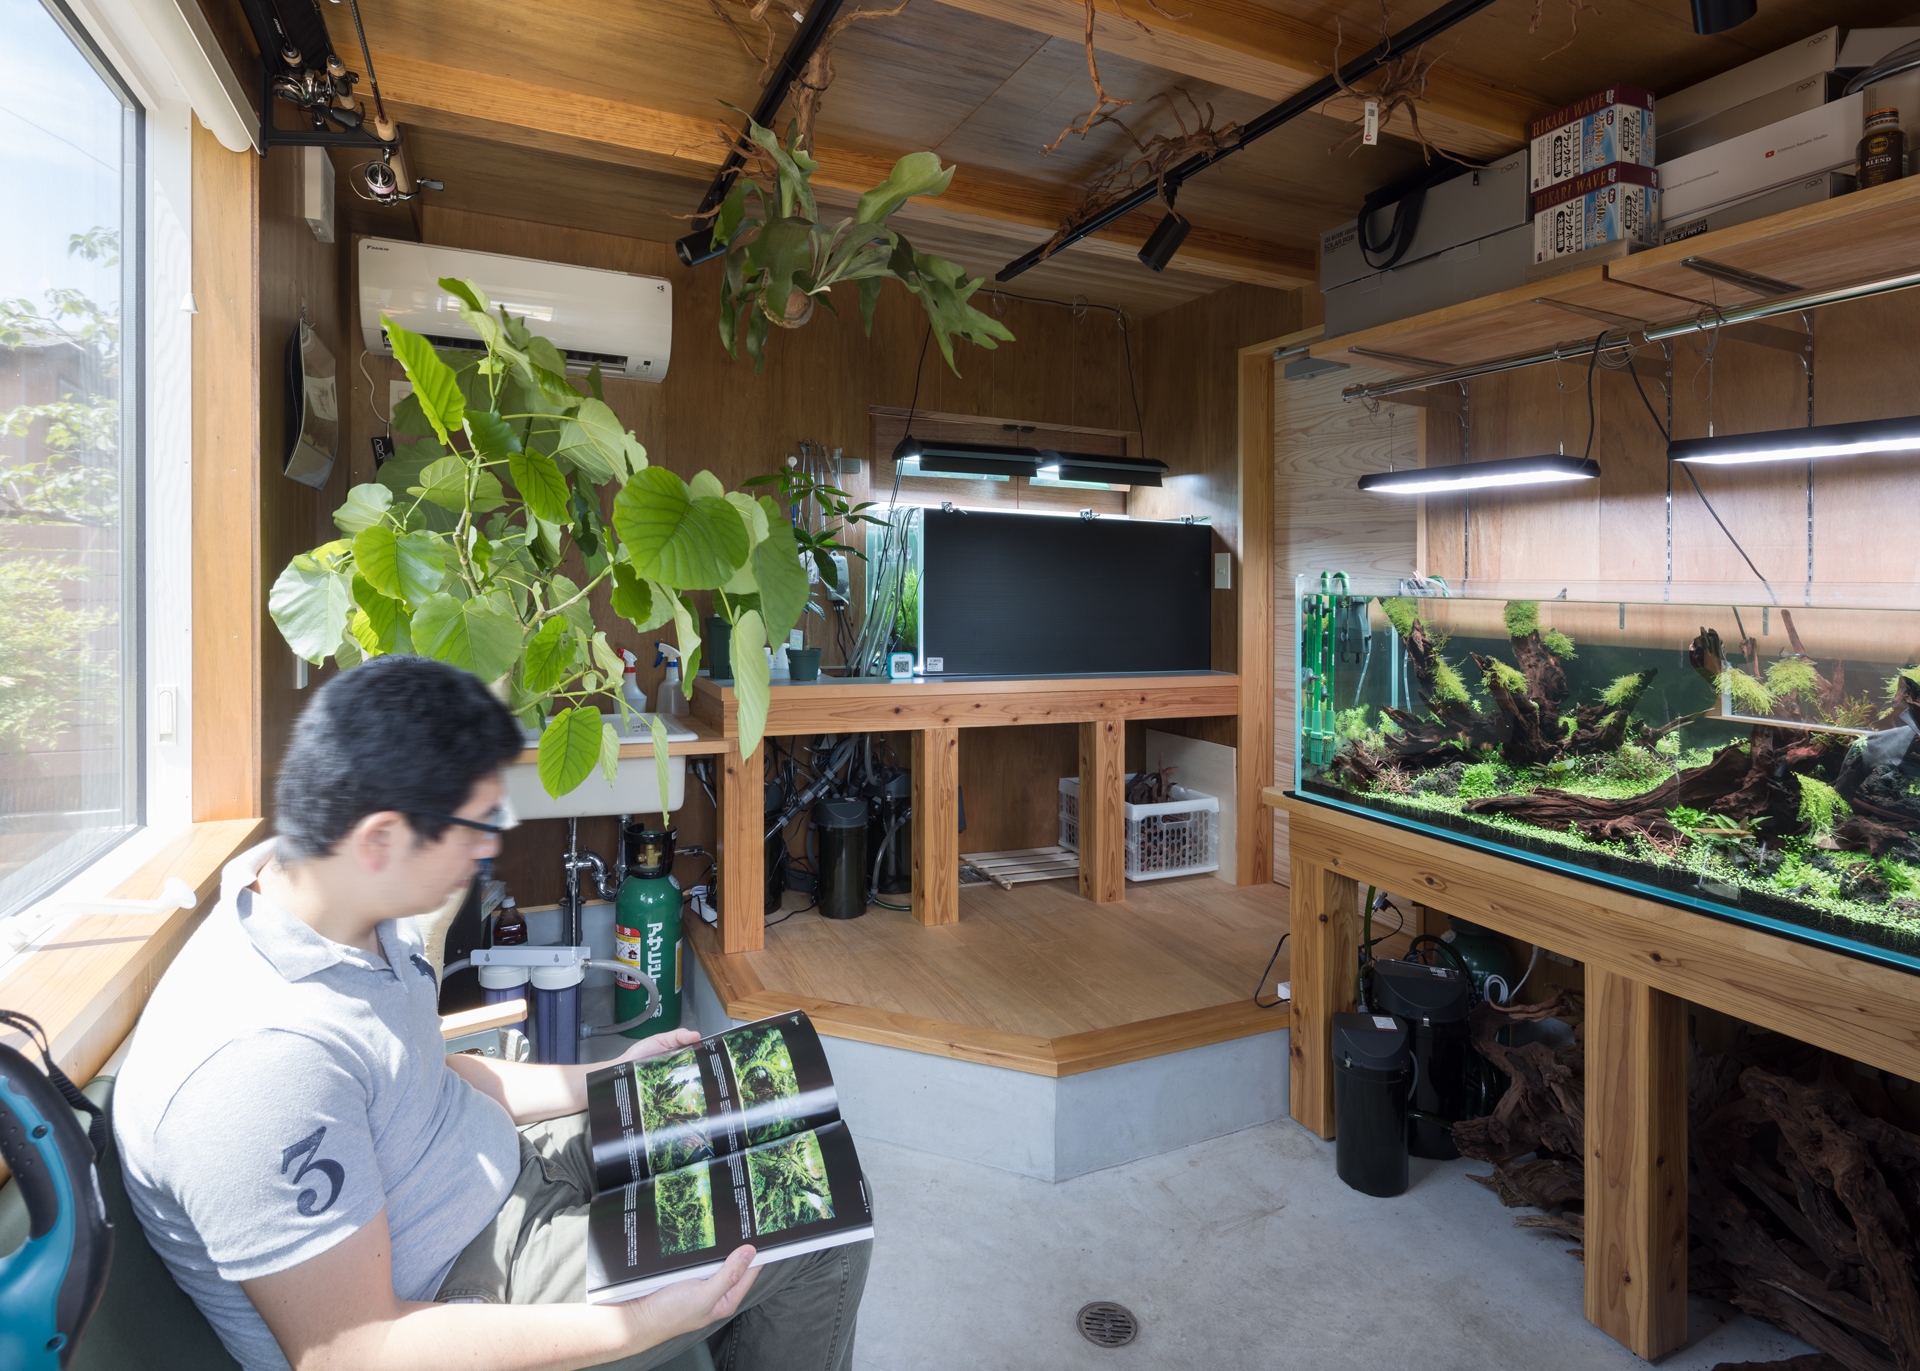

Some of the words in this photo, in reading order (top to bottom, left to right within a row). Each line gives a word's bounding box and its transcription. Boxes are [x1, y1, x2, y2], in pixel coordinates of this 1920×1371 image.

[1533, 108, 1570, 137] HIKARI
[1574, 92, 1606, 119] WAVE
[1563, 126, 1572, 178] ブラックホール
[1796, 138, 1813, 148] Aquatic
[1813, 133, 1829, 142] Studio
[1865, 156, 1892, 168] BLEND
[1536, 185, 1572, 211] HIKARI
[1576, 170, 1607, 194] WAVE
[1324, 239, 1341, 251] SOLAR
[1342, 233, 1355, 244] RGB
[1565, 203, 1574, 253] ブラックホール
[281, 1126, 345, 1217] 3
